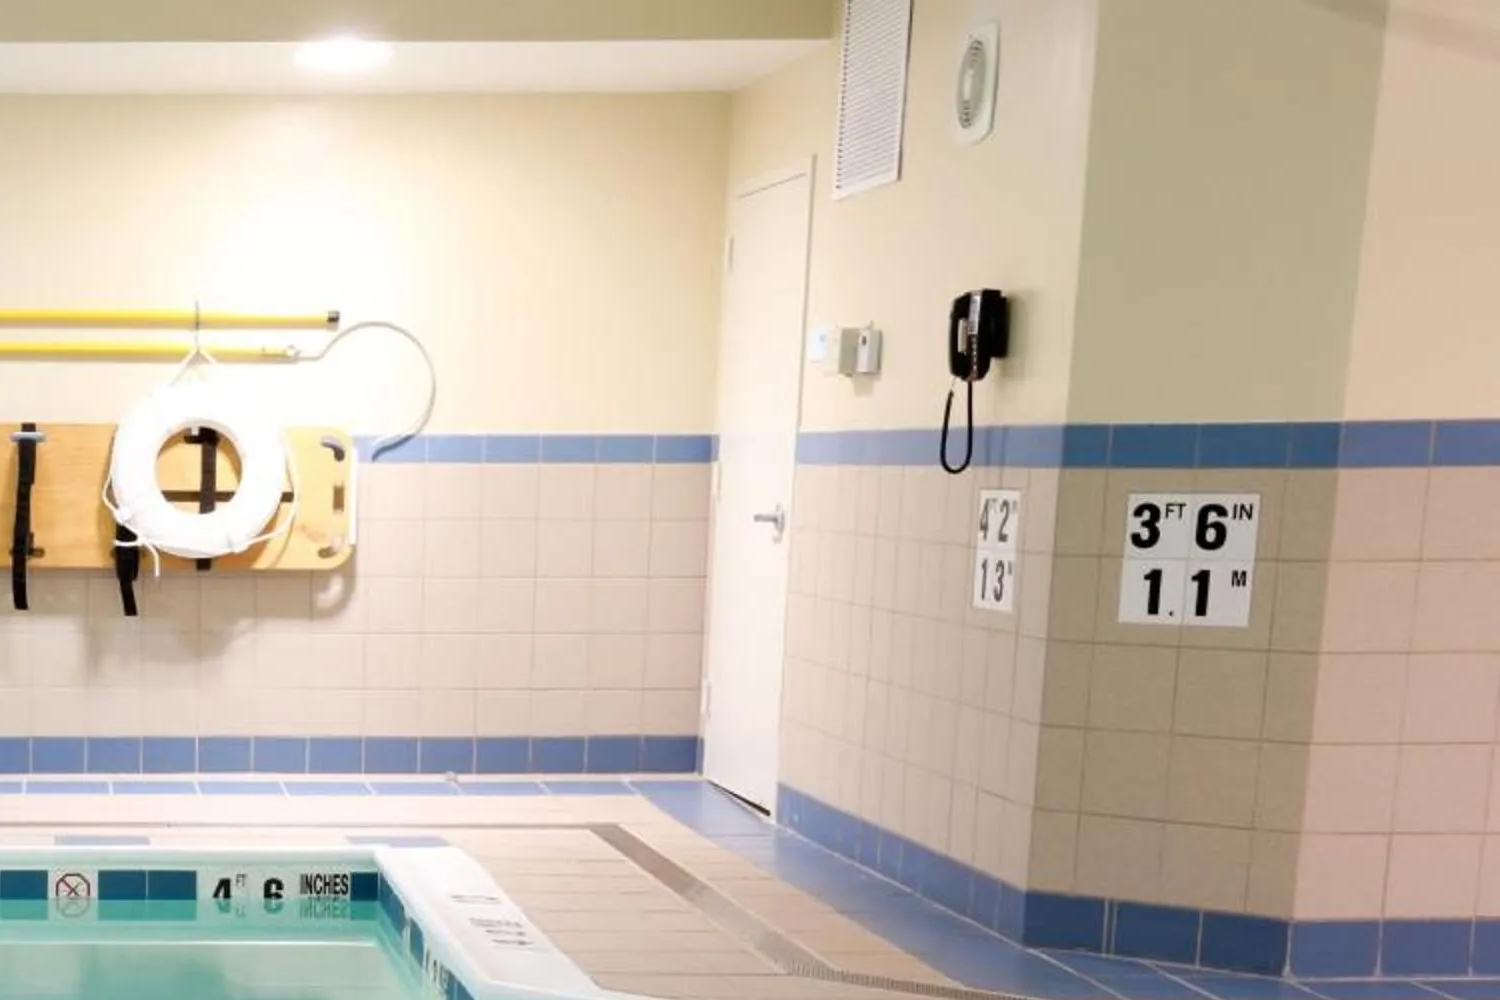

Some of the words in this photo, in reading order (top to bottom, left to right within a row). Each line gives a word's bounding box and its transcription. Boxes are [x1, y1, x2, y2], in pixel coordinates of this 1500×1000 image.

[1130, 502, 1161, 549] 3
[1165, 503, 1187, 520] FT
[1195, 503, 1228, 551] 6
[1233, 503, 1253, 520] IN
[1231, 570, 1247, 588] M
[300, 873, 349, 895] INCHES
